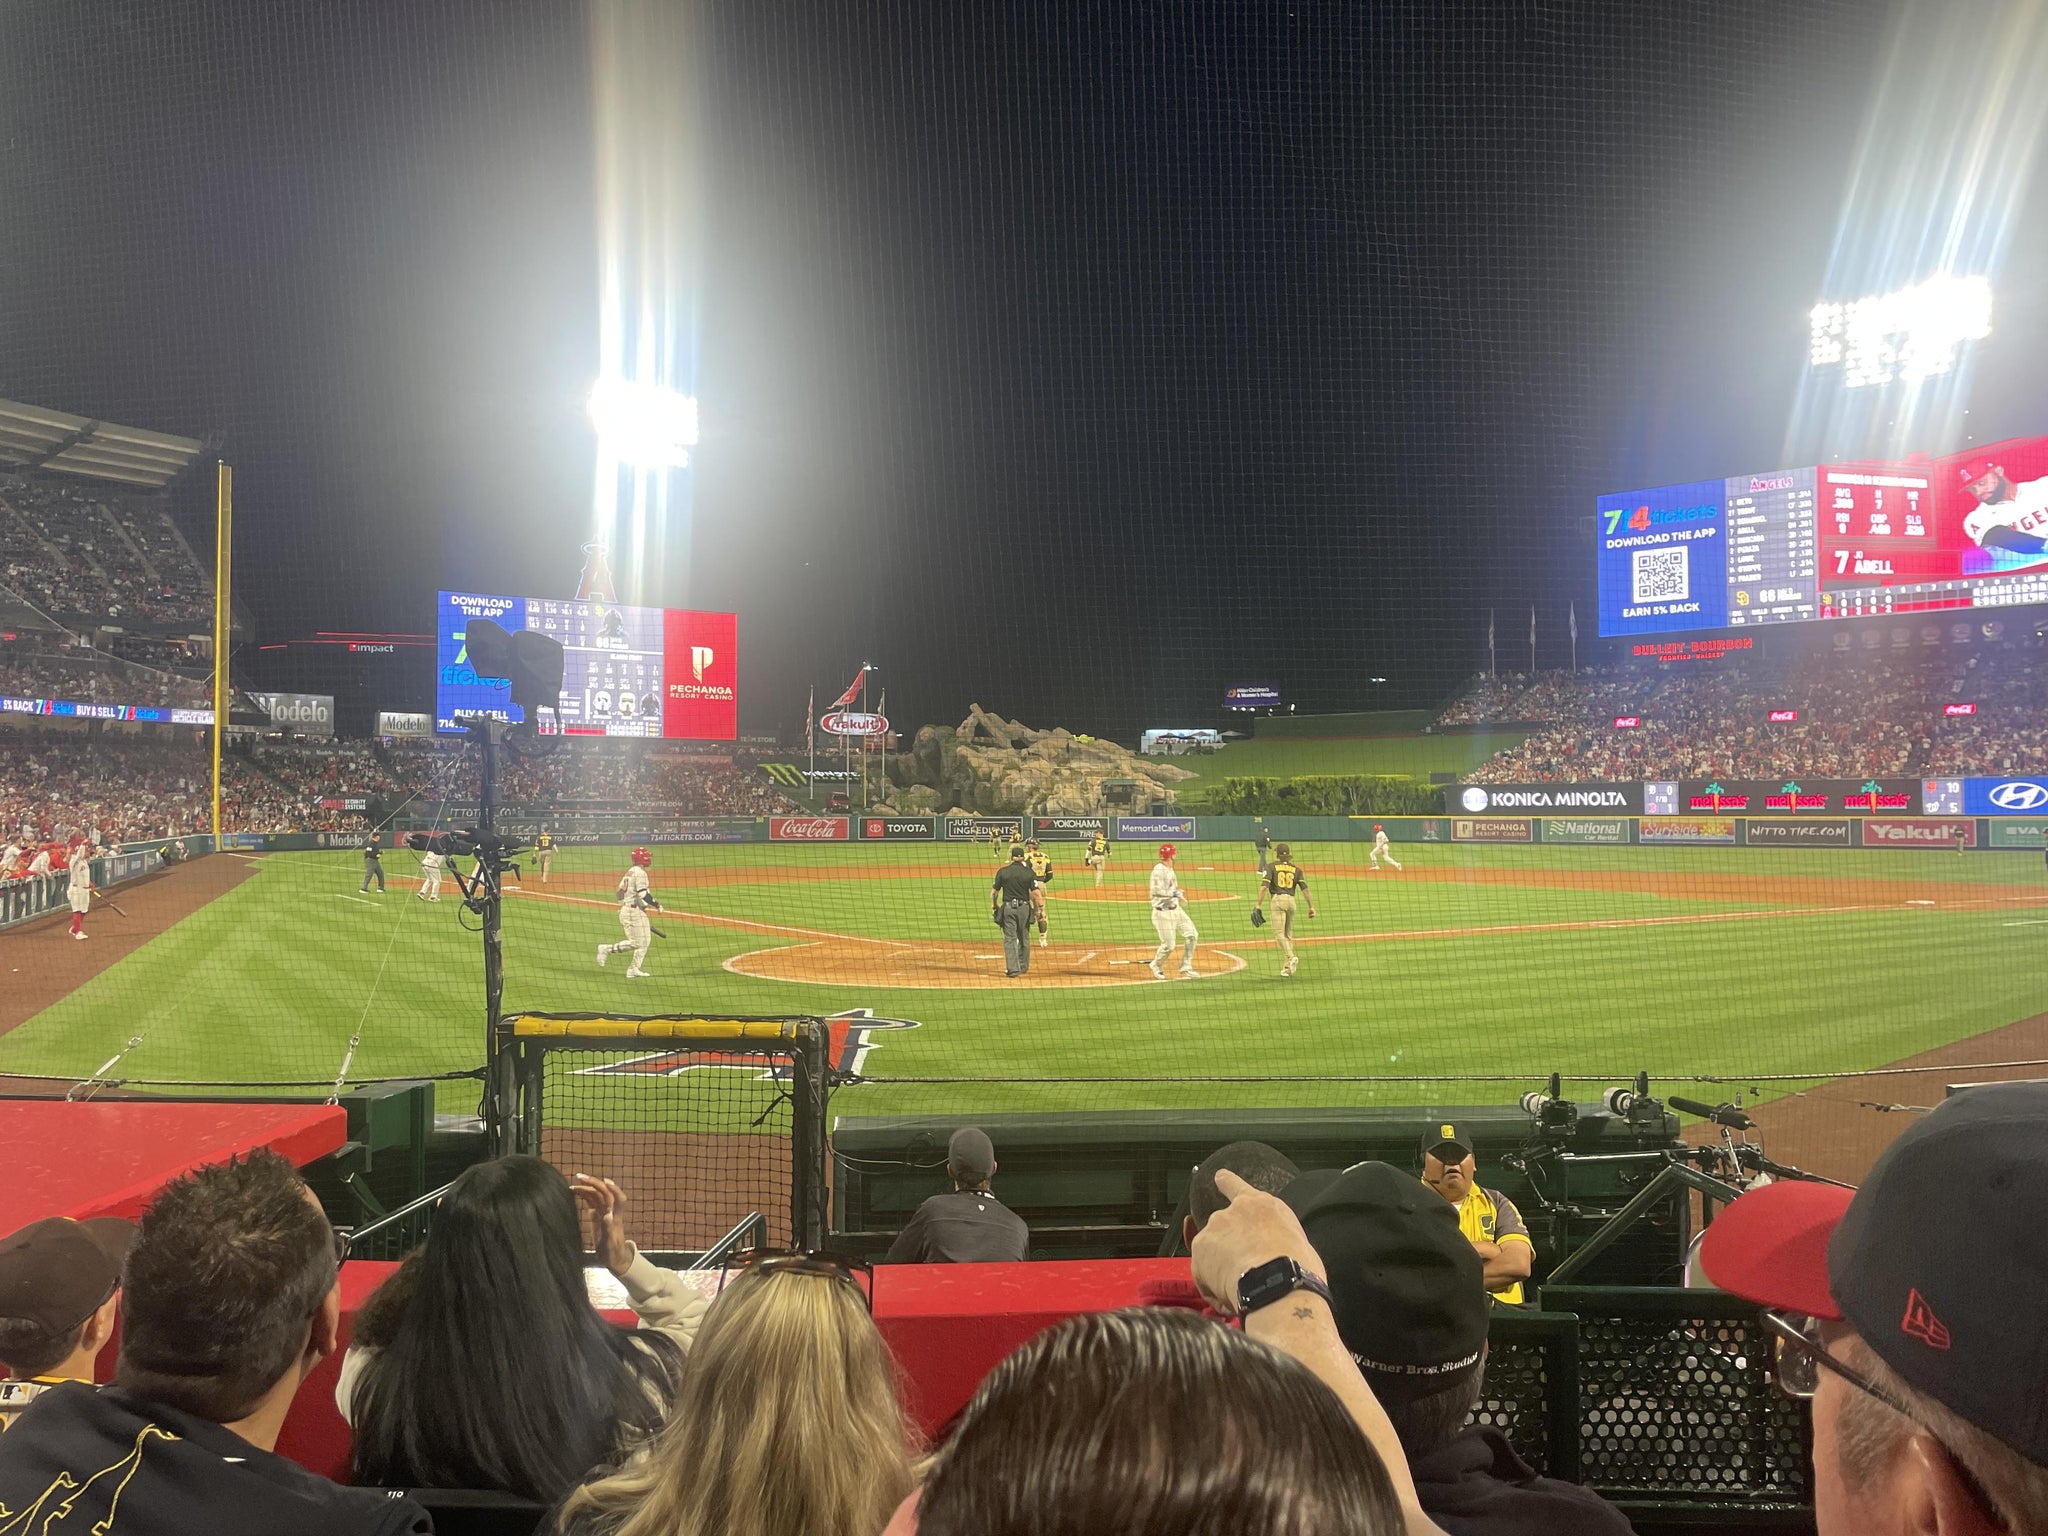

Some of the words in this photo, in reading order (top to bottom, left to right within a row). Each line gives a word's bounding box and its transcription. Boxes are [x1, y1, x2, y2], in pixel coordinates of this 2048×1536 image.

[1606, 534, 1670, 549] DOWNLOAD
[1671, 530, 1692, 542] THE
[1693, 527, 1716, 539] APP
[1834, 550, 1849, 574] 7
[1854, 560, 1894, 574] ADELL
[452, 595, 513, 610] DOWNLOAD
[1885, 605, 1892, 613] 2
[461, 605, 486, 616] THE
[483, 607, 504, 618] APP
[1622, 606, 1651, 618] EARN
[1653, 605, 1668, 616] 5%
[1669, 602, 1700, 614] BACK
[357, 644, 394, 653] impact
[1633, 642, 1686, 656] BULLEIT
[1691, 637, 1753, 652] BOURBON
[670, 684, 732, 697] PECHANGA
[704, 694, 733, 702] CASINO
[13, 699, 34, 712] BACK
[76, 705, 91, 715] BUY
[98, 706, 116, 718] SELL
[259, 696, 329, 722] Modelo
[385, 716, 426, 731] Modelo
[1946, 782, 1960, 793] 10
[1492, 792, 1552, 807] KONICA
[1555, 791, 1628, 806] MINOLTA
[1949, 802, 1958, 813] 5
[780, 818, 839, 839] Coca-Cola
[887, 824, 927, 833] TOYOTA
[1052, 819, 1103, 828] YOKOHAMA
[1121, 823, 1181, 833] MemorialCare
[1475, 823, 1526, 831] PECHANGA
[1566, 821, 1621, 835] National
[1644, 824, 1698, 838] Surfside
[1751, 826, 1786, 836] NITTO
[1790, 826, 1846, 837] TIRE.COM
[330, 834, 363, 847] Modelo
[1351, 1352, 1403, 1374] Warner
[1405, 1365, 1440, 1376] Bros.
